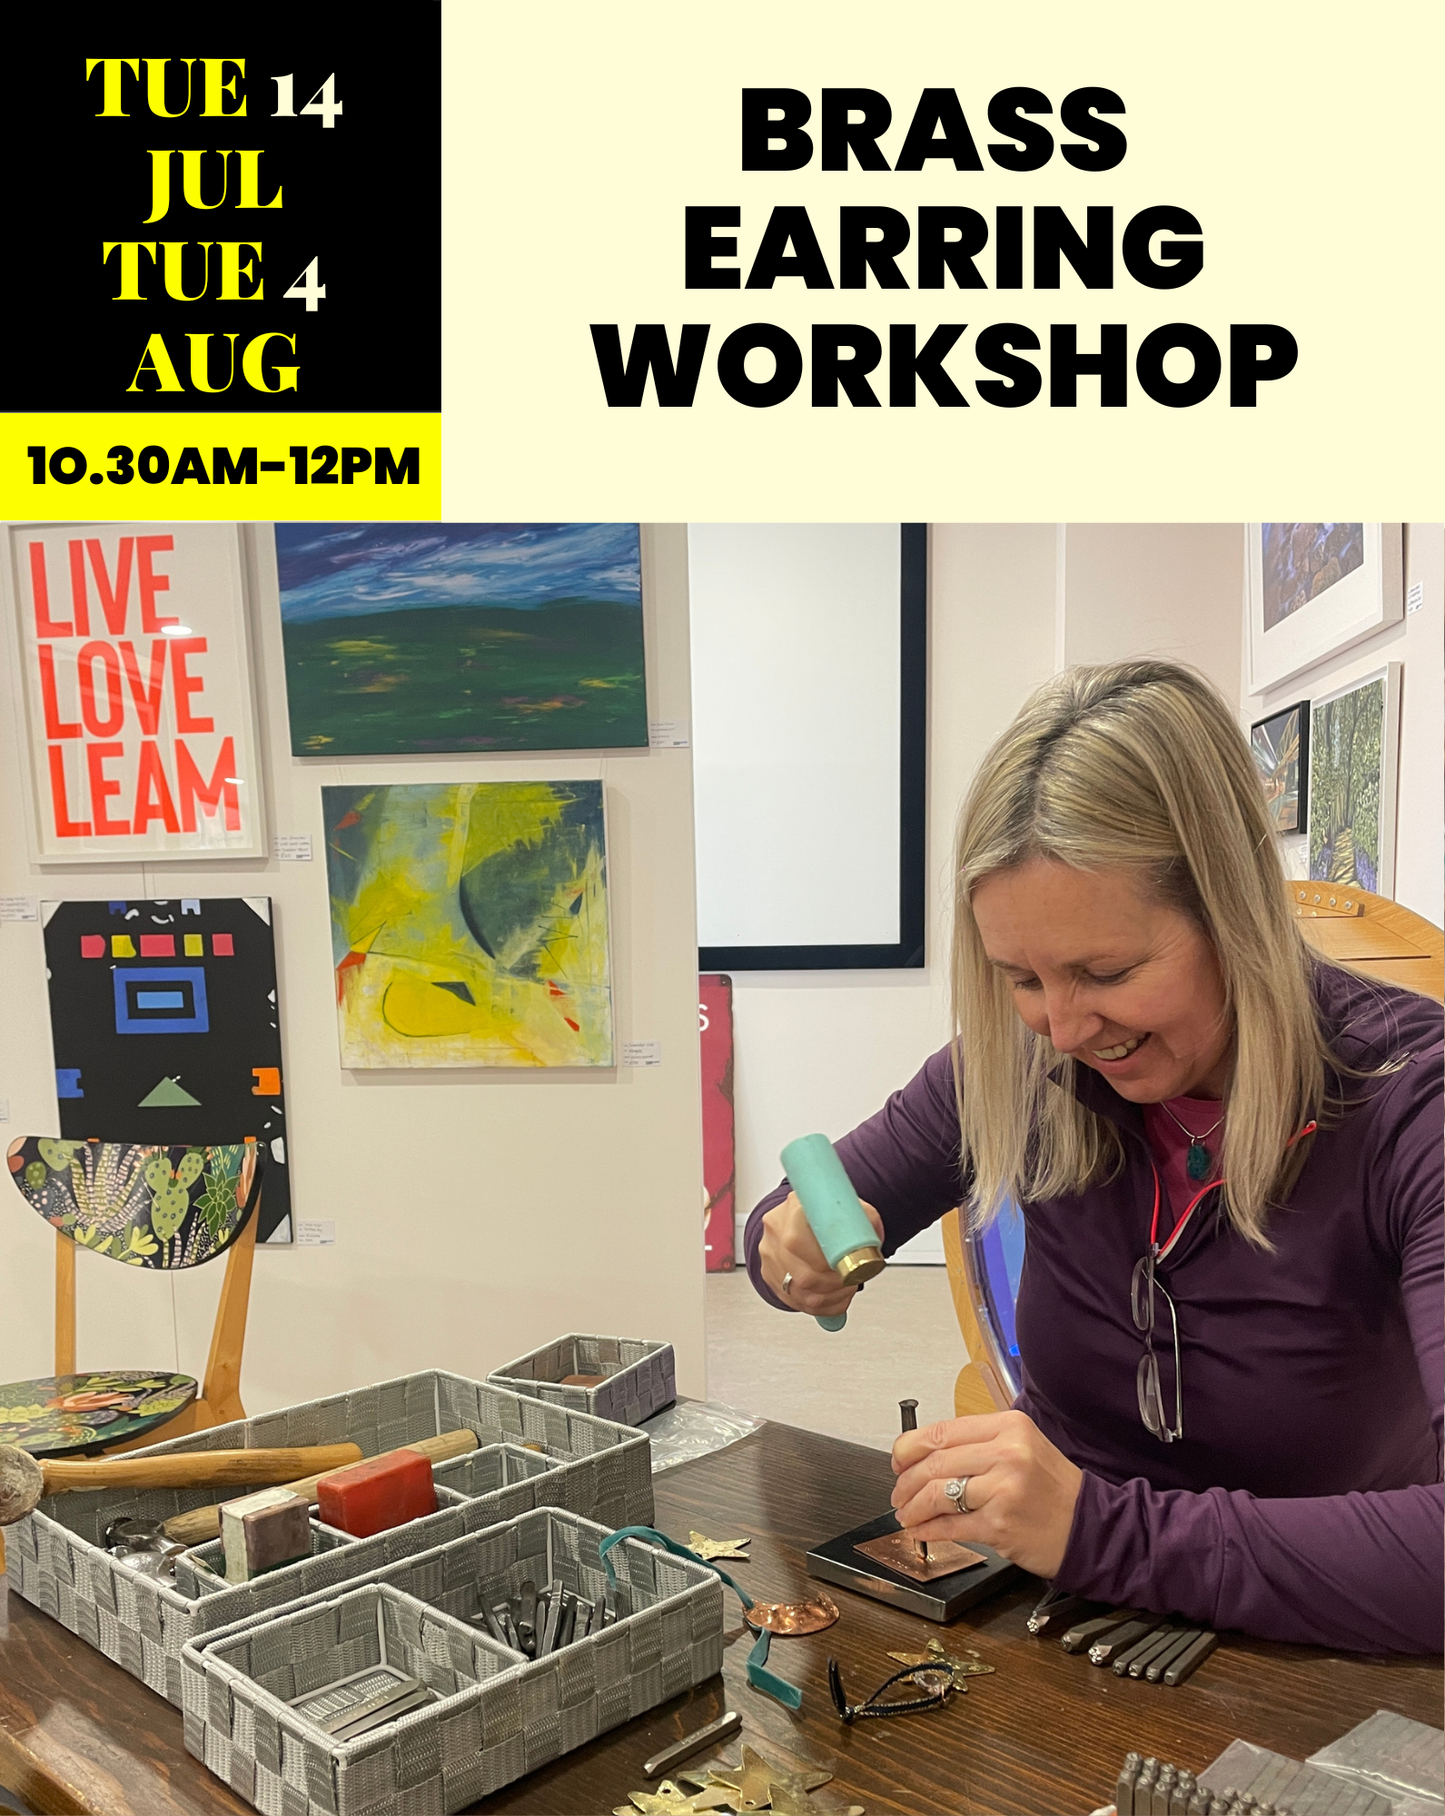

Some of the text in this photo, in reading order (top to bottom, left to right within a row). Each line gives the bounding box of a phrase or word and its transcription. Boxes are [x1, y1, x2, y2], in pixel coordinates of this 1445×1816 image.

[29, 535, 179, 638] LIVE
[37, 637, 214, 739] LOVE
[47, 736, 241, 838] LEAM
